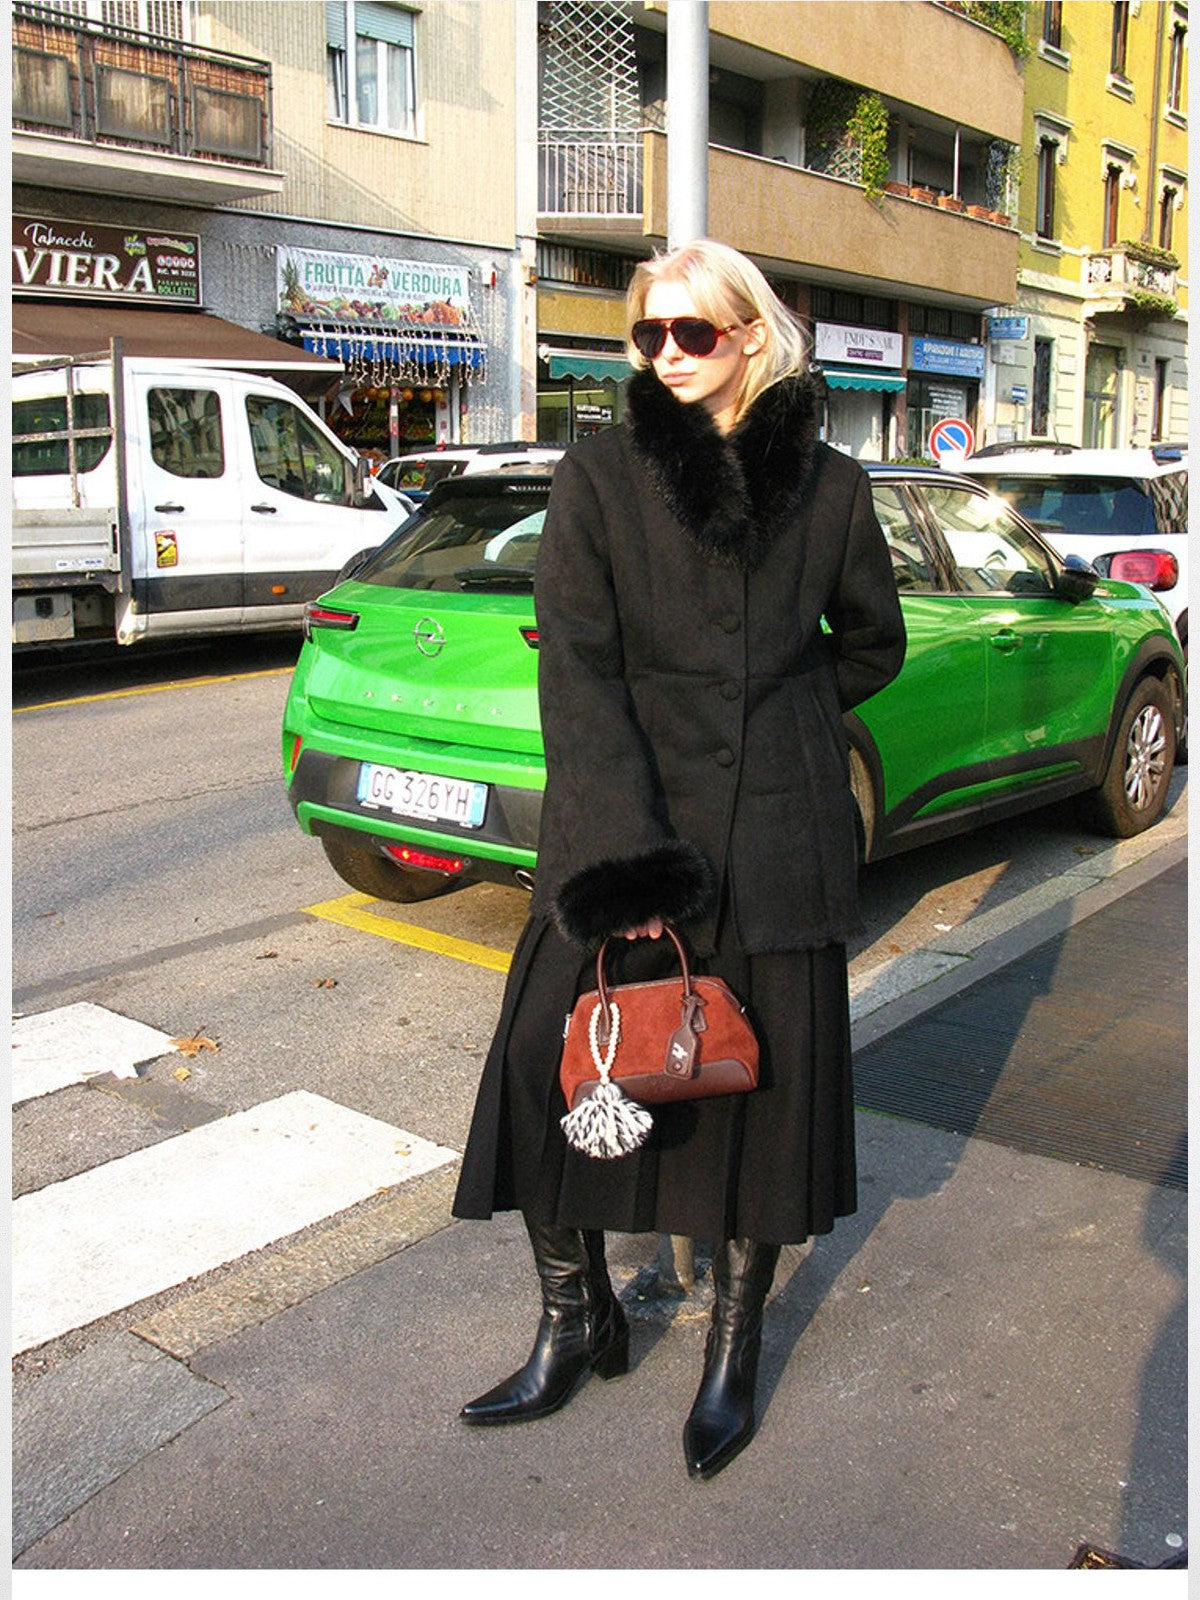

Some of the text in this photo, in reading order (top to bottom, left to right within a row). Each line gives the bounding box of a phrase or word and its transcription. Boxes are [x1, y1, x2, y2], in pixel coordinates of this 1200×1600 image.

[23, 223, 95, 249] Tabacchi
[12, 246, 155, 293] VIERA
[305, 262, 364, 287] FRUTTA
[392, 271, 462, 297] VERDURA
[371, 771, 396, 800] GG
